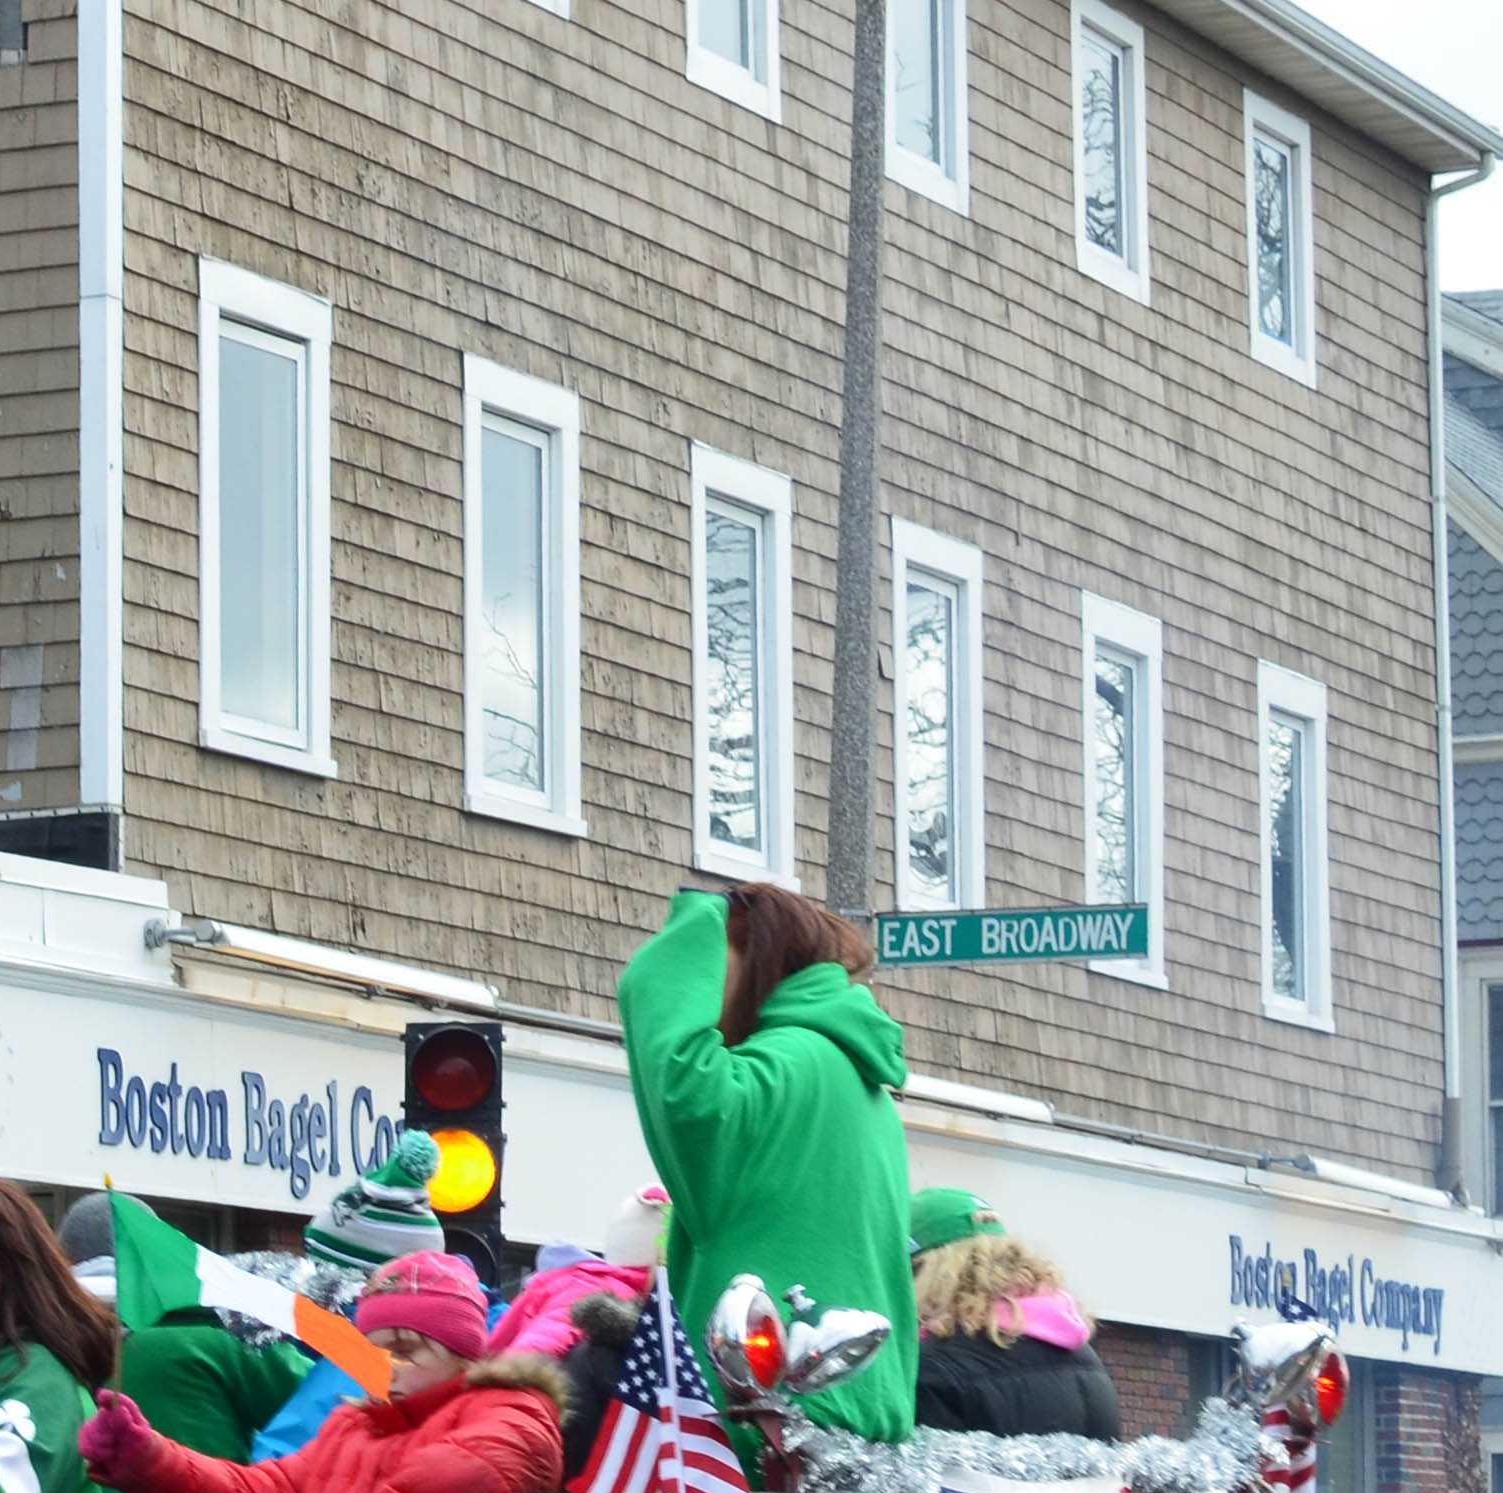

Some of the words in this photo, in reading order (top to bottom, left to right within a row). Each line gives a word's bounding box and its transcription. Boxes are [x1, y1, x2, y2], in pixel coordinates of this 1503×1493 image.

[882, 918, 958, 958] EAST
[980, 912, 1135, 955] BROADWAY
[96, 1047, 232, 1161] Boston
[241, 1070, 342, 1200] Bagel
[1303, 1247, 1356, 1337] Bagel
[1360, 1257, 1444, 1356] Company
